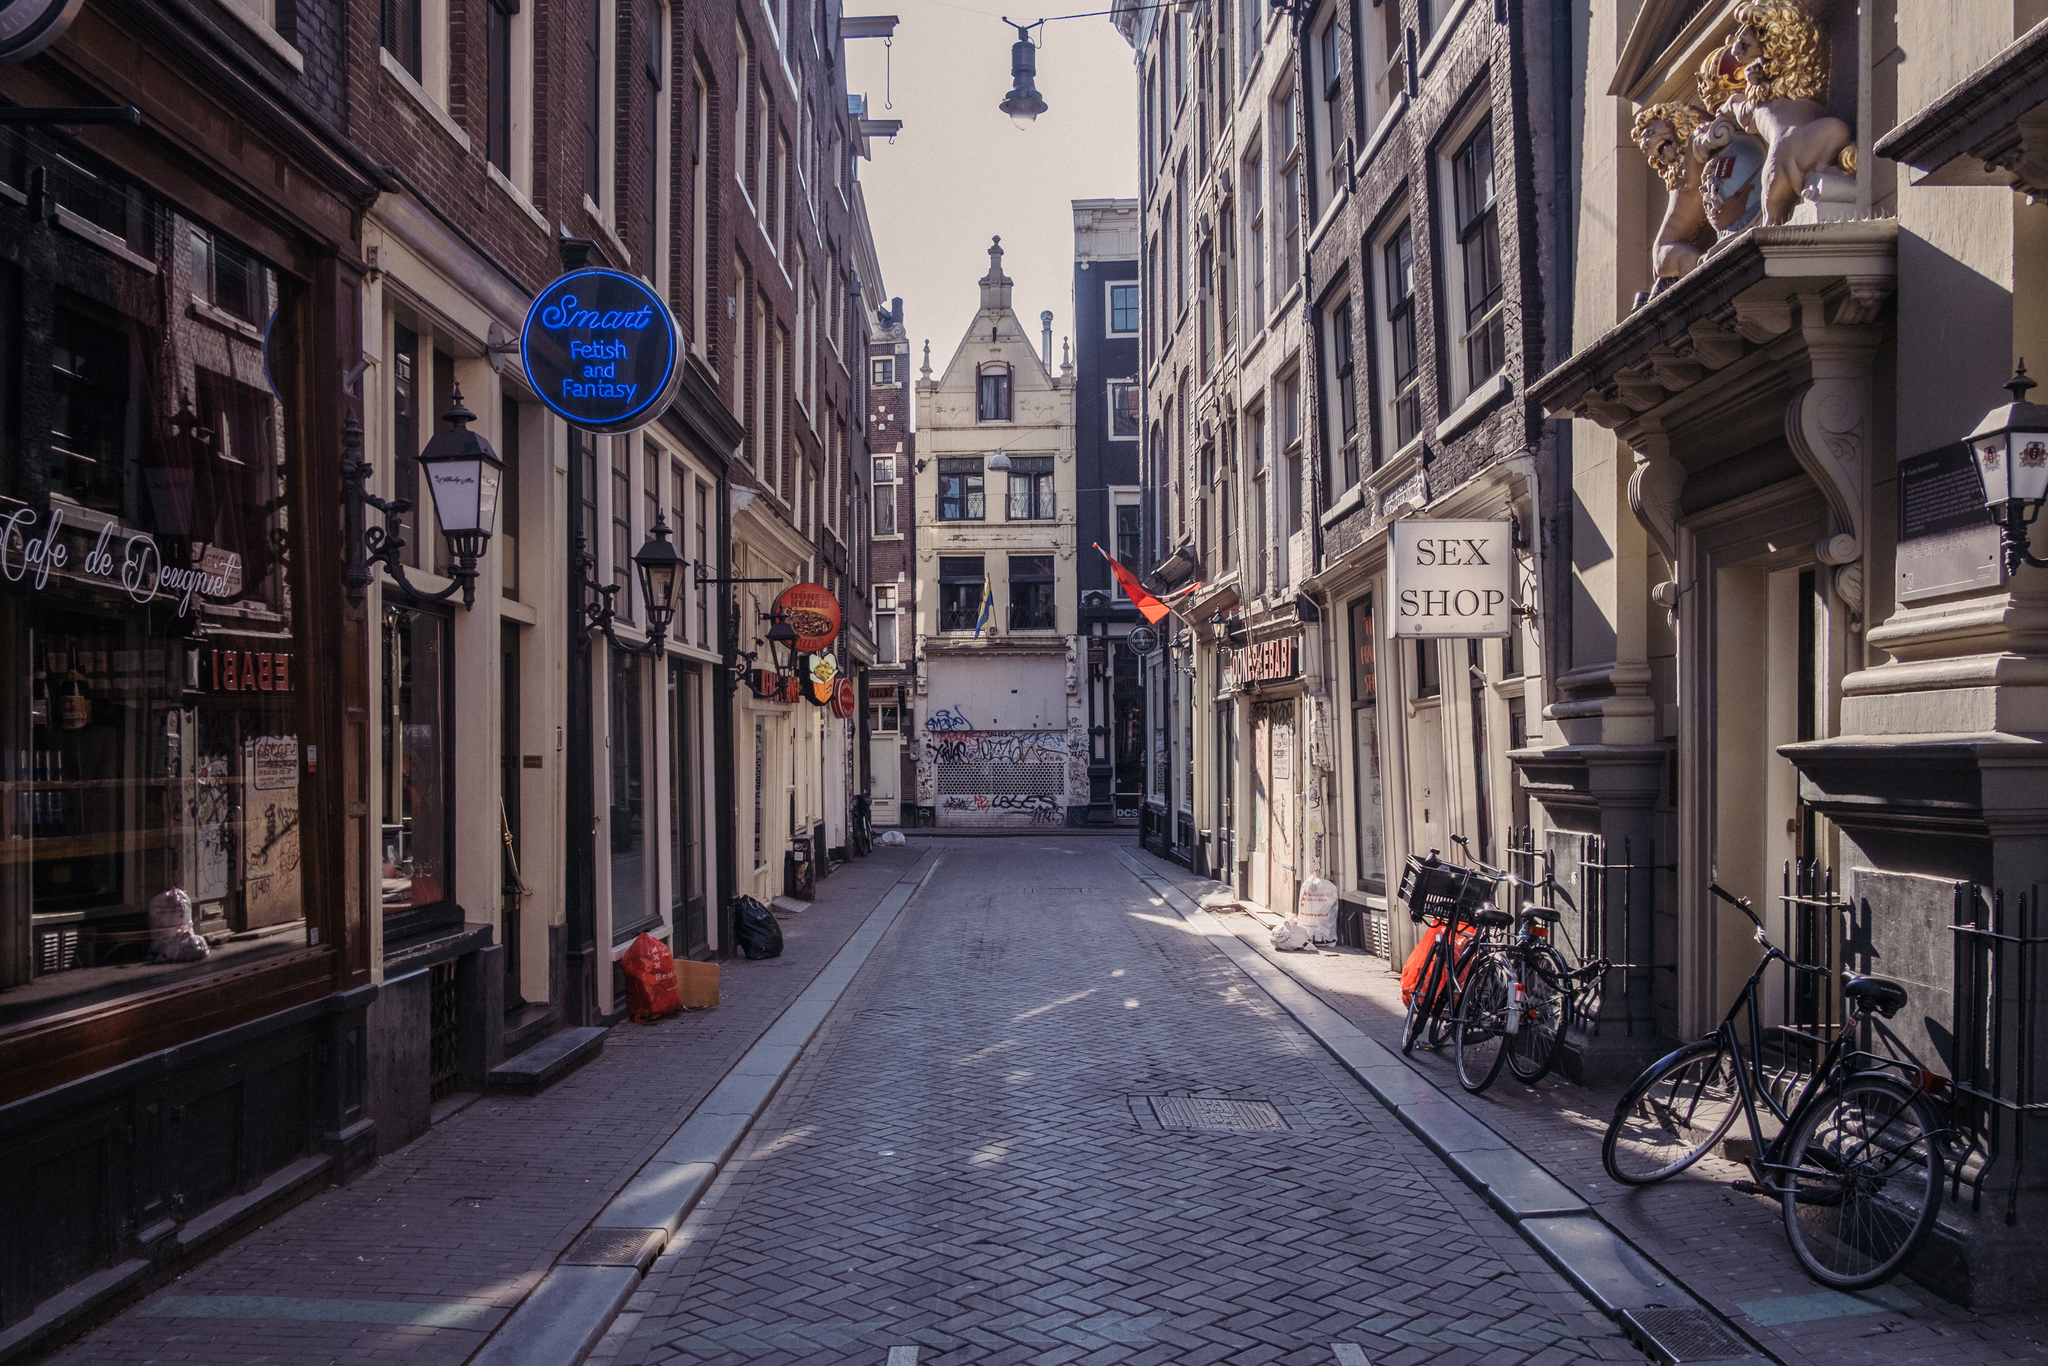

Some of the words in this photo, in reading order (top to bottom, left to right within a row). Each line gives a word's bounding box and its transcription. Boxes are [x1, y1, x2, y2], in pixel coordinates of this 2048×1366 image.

[542, 294, 653, 330] Smart
[570, 338, 628, 360] Fetish
[583, 361, 615, 379] and
[562, 379, 638, 404] Fantasy
[1416, 538, 1491, 566] SEX
[85, 521, 114, 577] de
[121, 534, 243, 618] Deugniet
[1400, 589, 1504, 617] SHOP
